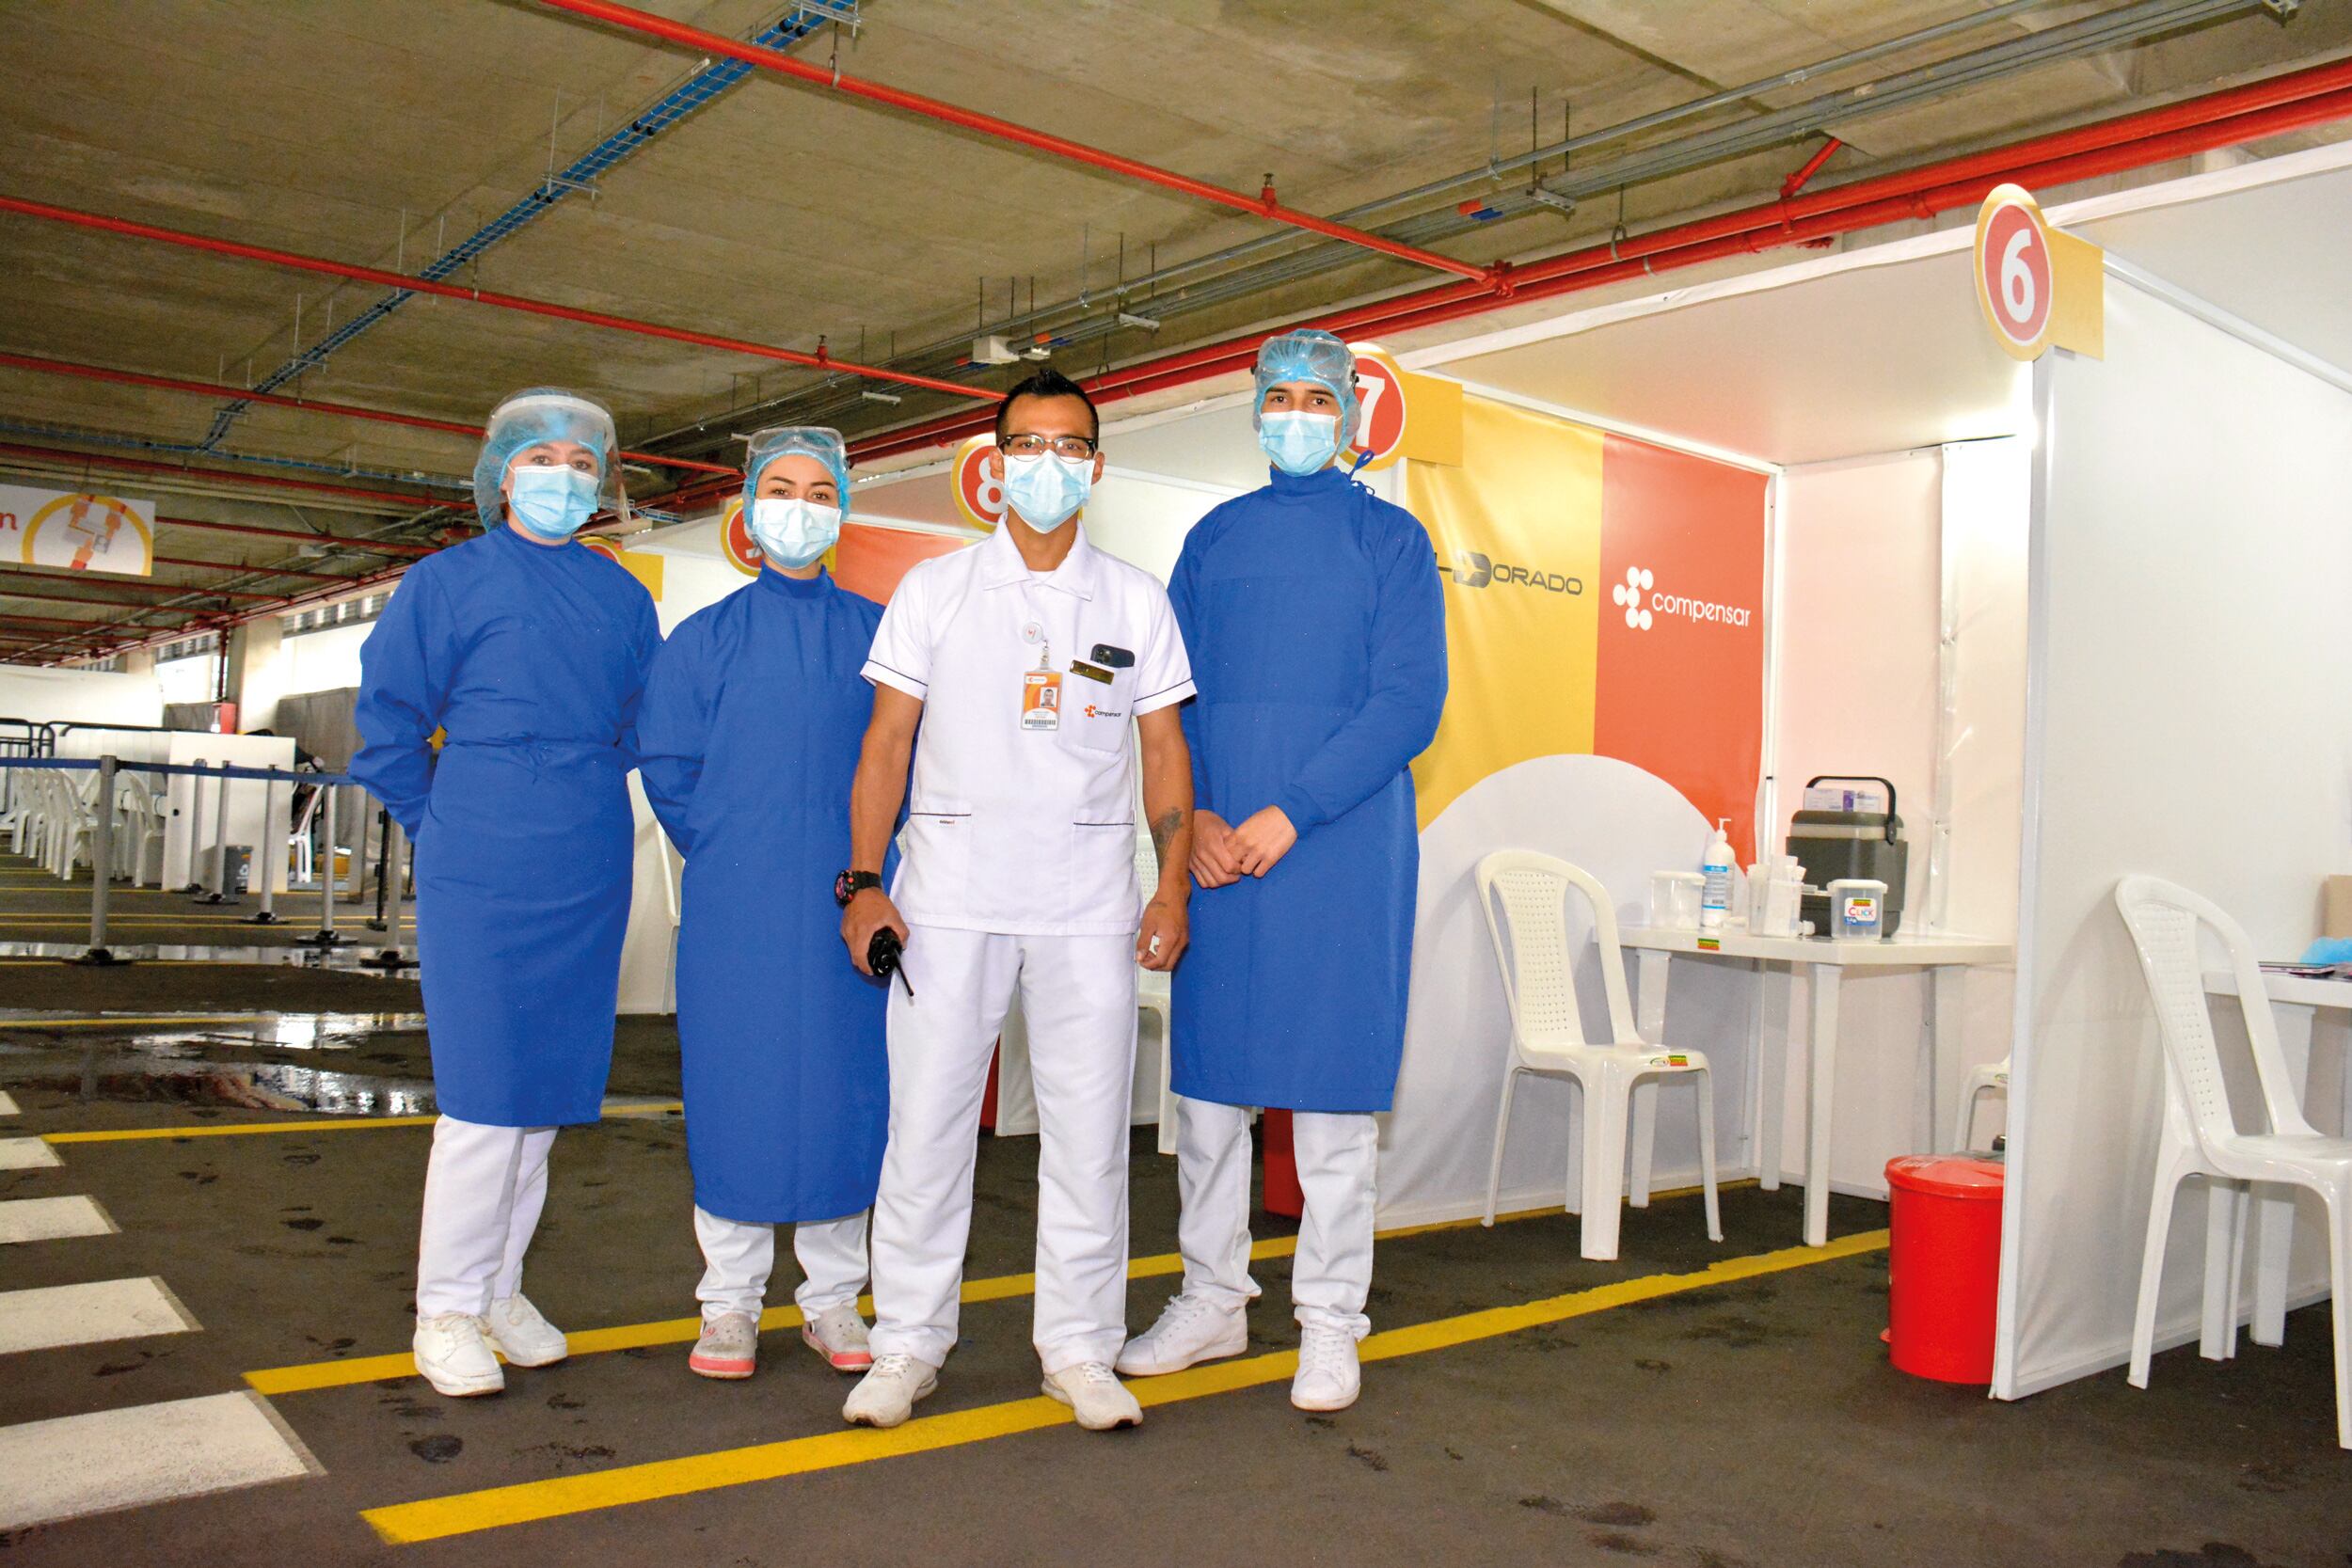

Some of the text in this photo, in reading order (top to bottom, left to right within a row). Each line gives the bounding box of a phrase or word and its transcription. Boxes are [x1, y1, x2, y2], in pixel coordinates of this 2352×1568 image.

[2001, 229, 2036, 324] 6
[1354, 373, 1386, 448] 7
[1652, 593, 1752, 627] compensar
